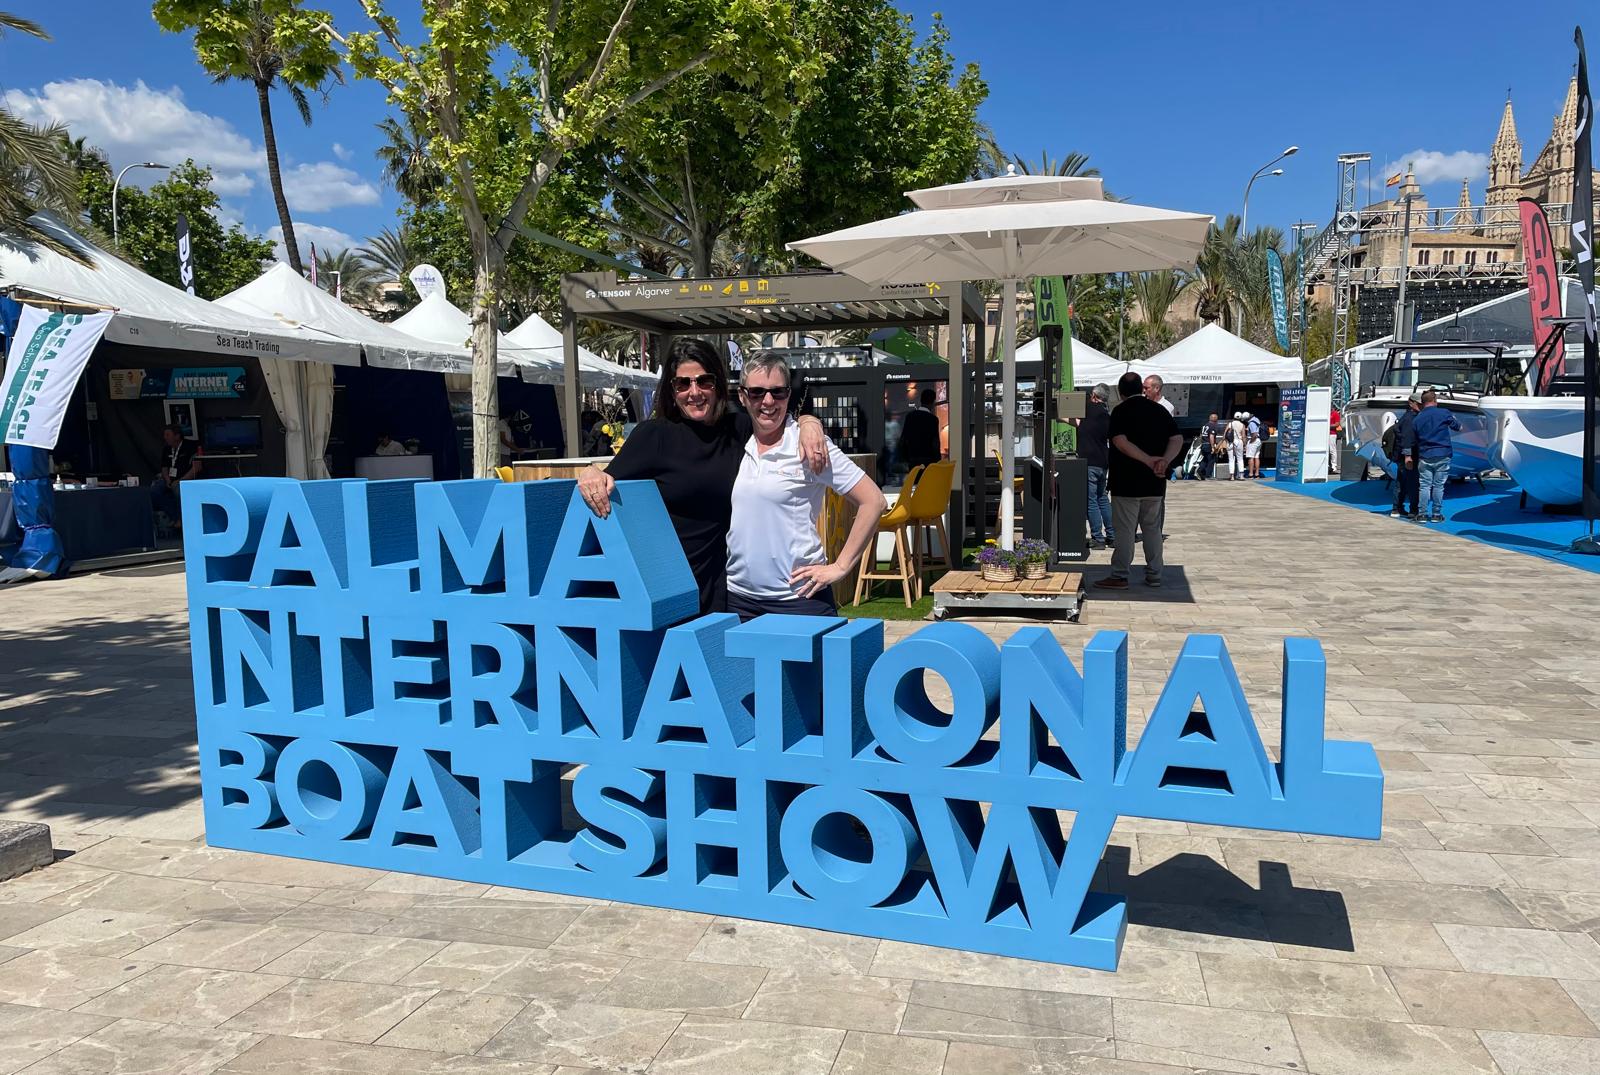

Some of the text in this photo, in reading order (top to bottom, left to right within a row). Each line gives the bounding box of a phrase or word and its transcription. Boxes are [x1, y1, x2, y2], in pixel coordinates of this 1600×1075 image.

[216, 335, 280, 354] Sea Teach Trading
[598, 290, 631, 298] RENSON
[635, 286, 671, 299] Algarve
[8, 328, 72, 440] SEA TEACH
[19, 343, 40, 372] School
[175, 376, 228, 387] INTERNET
[180, 477, 680, 612] PALMA
[190, 602, 1382, 836] INTERNATIONAL
[202, 729, 536, 866] BOAT
[570, 762, 1122, 938] SHOW
